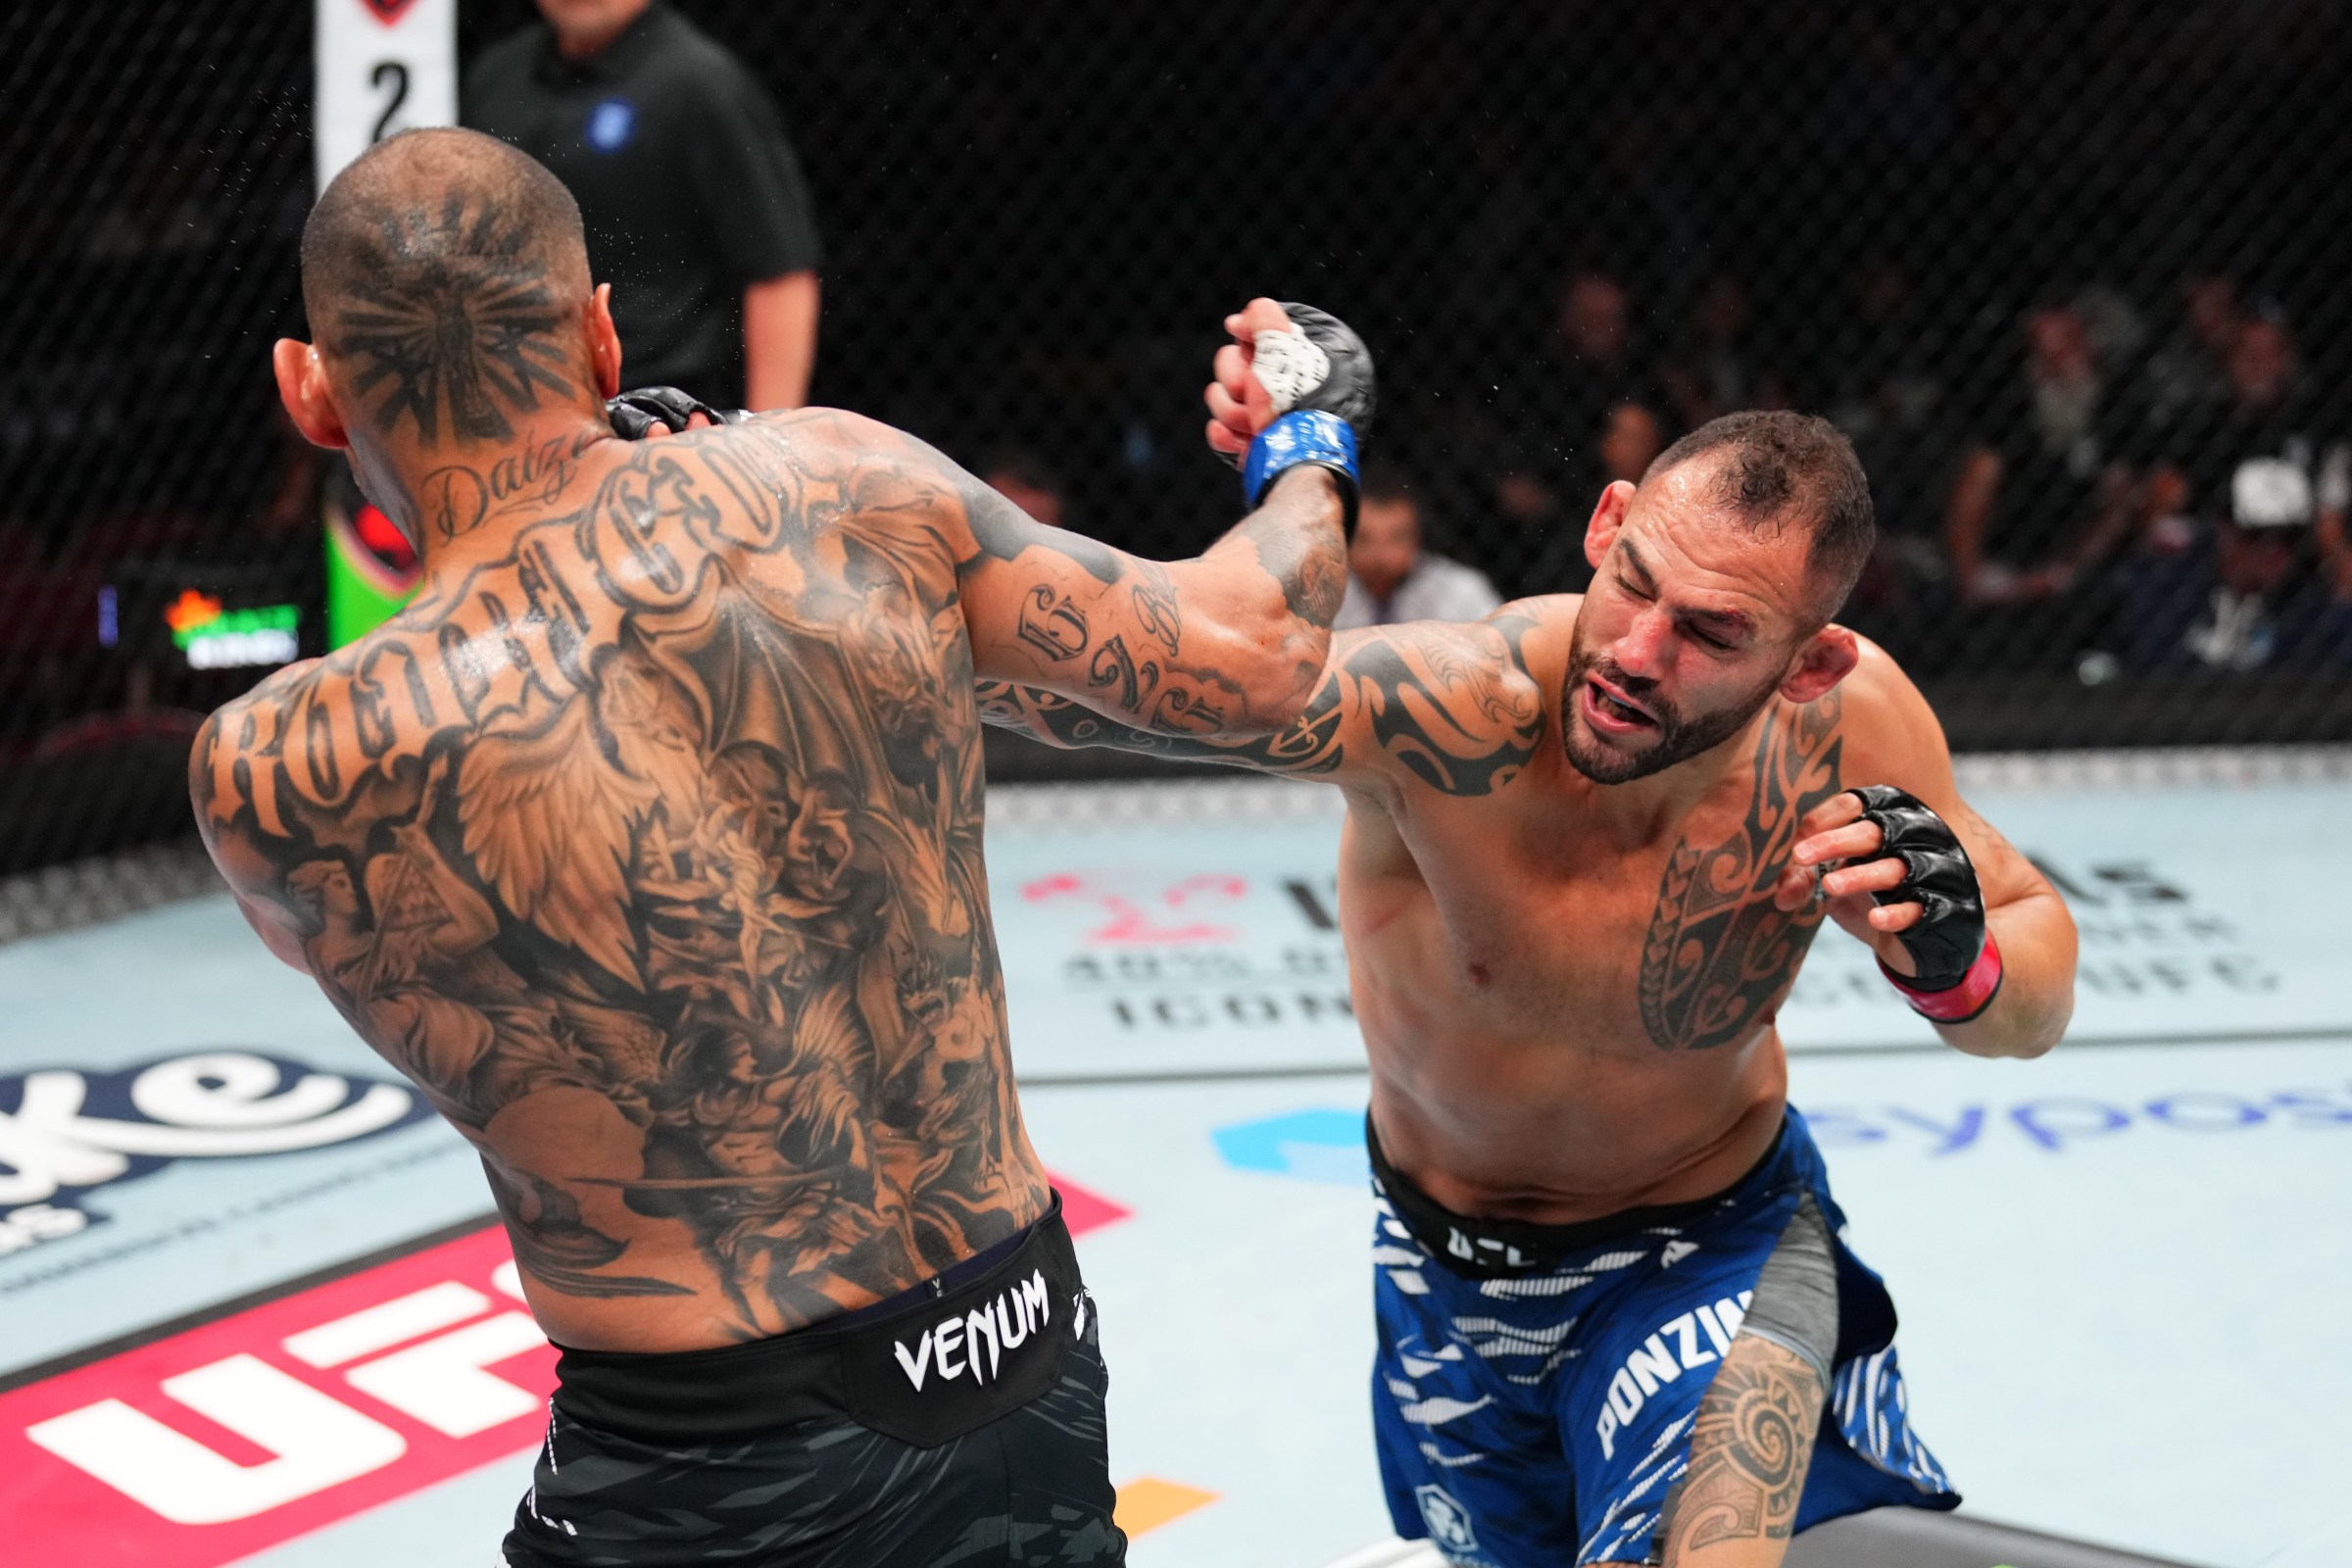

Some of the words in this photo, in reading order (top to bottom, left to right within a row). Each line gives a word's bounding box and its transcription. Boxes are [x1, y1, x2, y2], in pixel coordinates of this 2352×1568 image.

[371, 60, 409, 144] 2
[24, 1258, 551, 1525] UF
[894, 1268, 1050, 1393] VENUM
